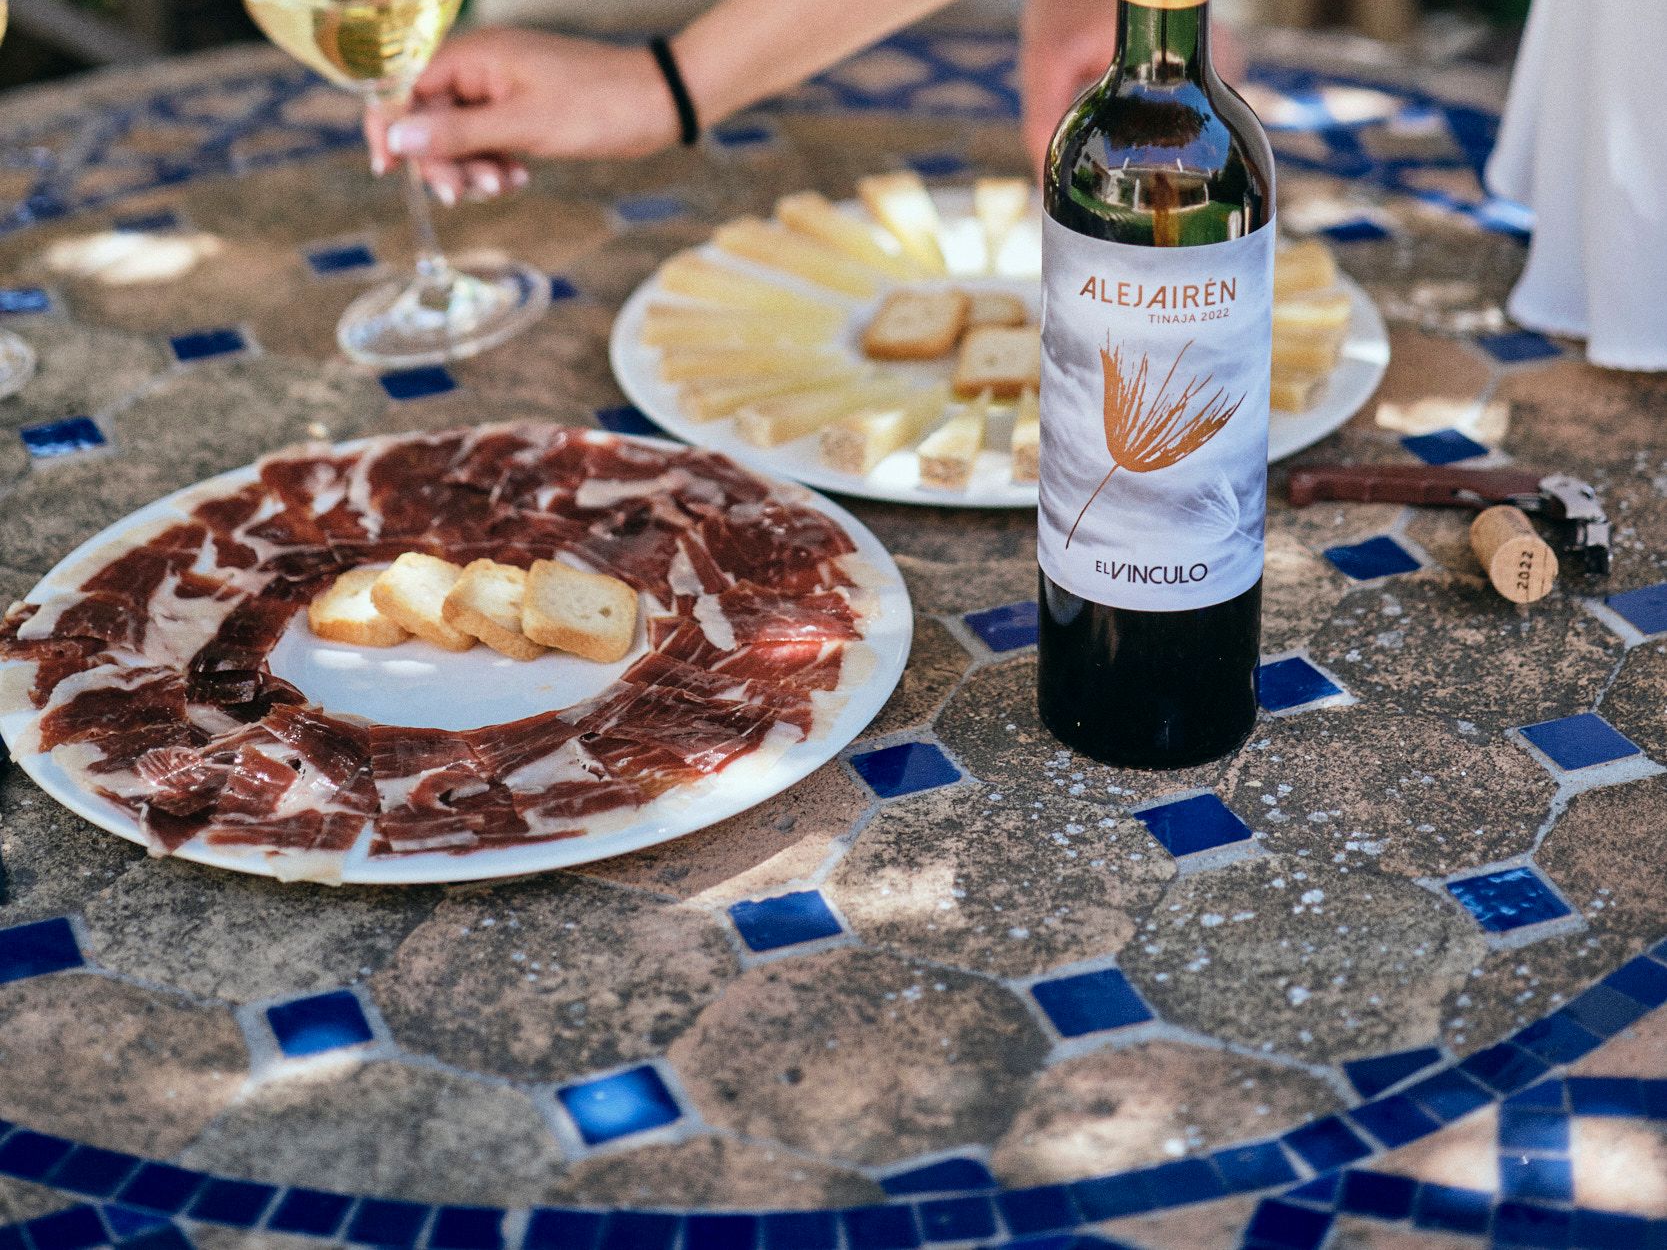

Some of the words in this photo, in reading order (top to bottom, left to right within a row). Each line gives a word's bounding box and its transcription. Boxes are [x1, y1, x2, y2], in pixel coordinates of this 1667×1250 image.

[1079, 275, 1237, 309] ALEJAIRÉN
[1148, 313, 1197, 324] TINAJA
[1200, 307, 1231, 322] 2022
[1516, 551, 1534, 590] 2022
